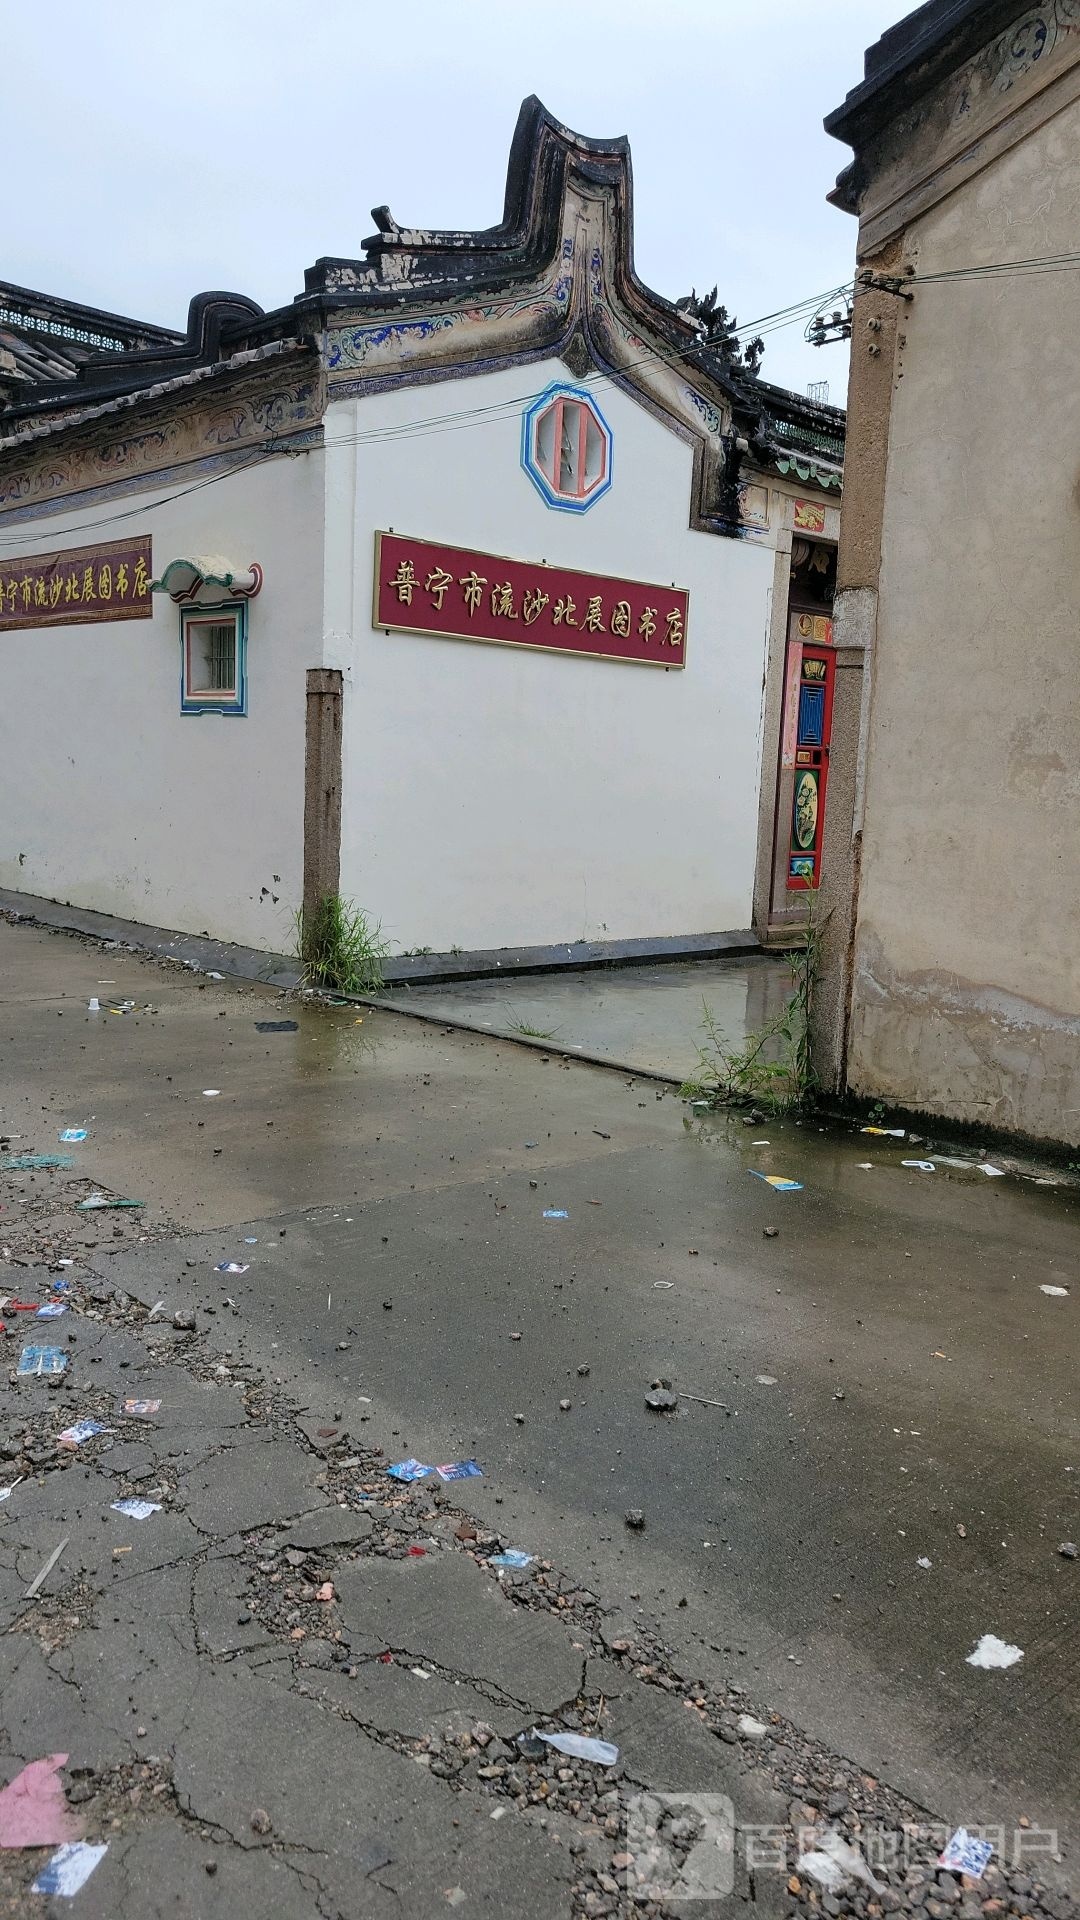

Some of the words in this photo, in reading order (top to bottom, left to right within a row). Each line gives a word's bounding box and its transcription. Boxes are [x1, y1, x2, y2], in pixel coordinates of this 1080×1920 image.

[389, 560, 683, 646] 普宁市流沙北展图书店
